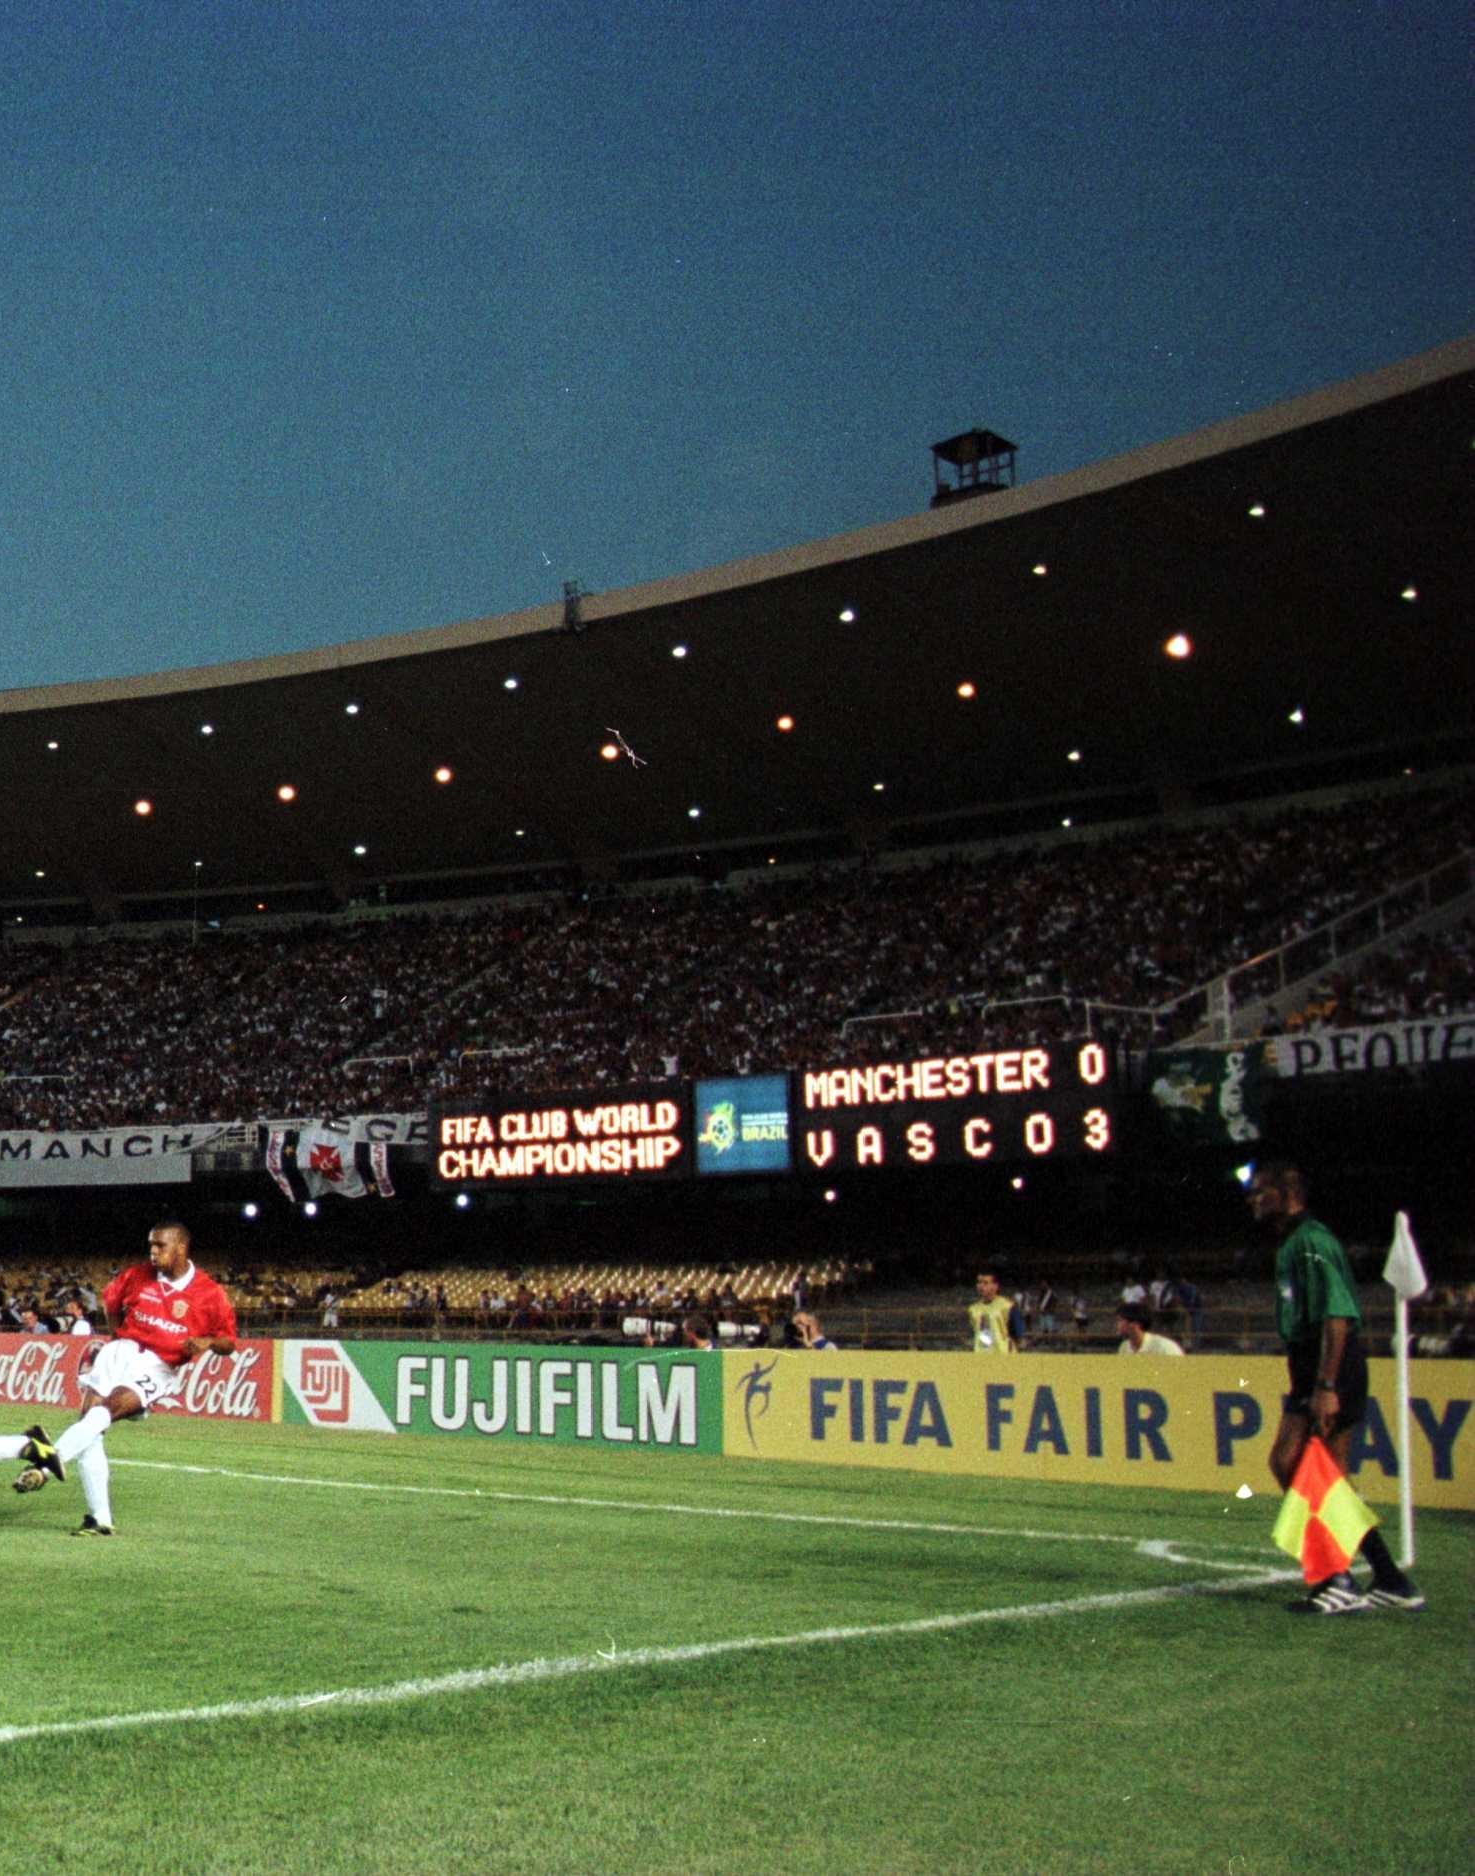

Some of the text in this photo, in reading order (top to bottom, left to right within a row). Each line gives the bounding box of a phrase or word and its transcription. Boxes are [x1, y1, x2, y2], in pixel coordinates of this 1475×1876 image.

[804, 1043, 1106, 1109] MANCHESTER 0
[441, 1116, 495, 1146] FIFA
[500, 1109, 567, 1141] CLUB
[573, 1101, 679, 1136] WORLD
[806, 1108, 1110, 1168] VASCO 3
[438, 1136, 682, 1180] CHAMPIONSHIP
[133, 1311, 188, 1334] SHARP
[135, 1374, 157, 1399] 22
[395, 1355, 698, 1447] FUJIFILM
[809, 1377, 1473, 1482] FIFA FAIR PAY
